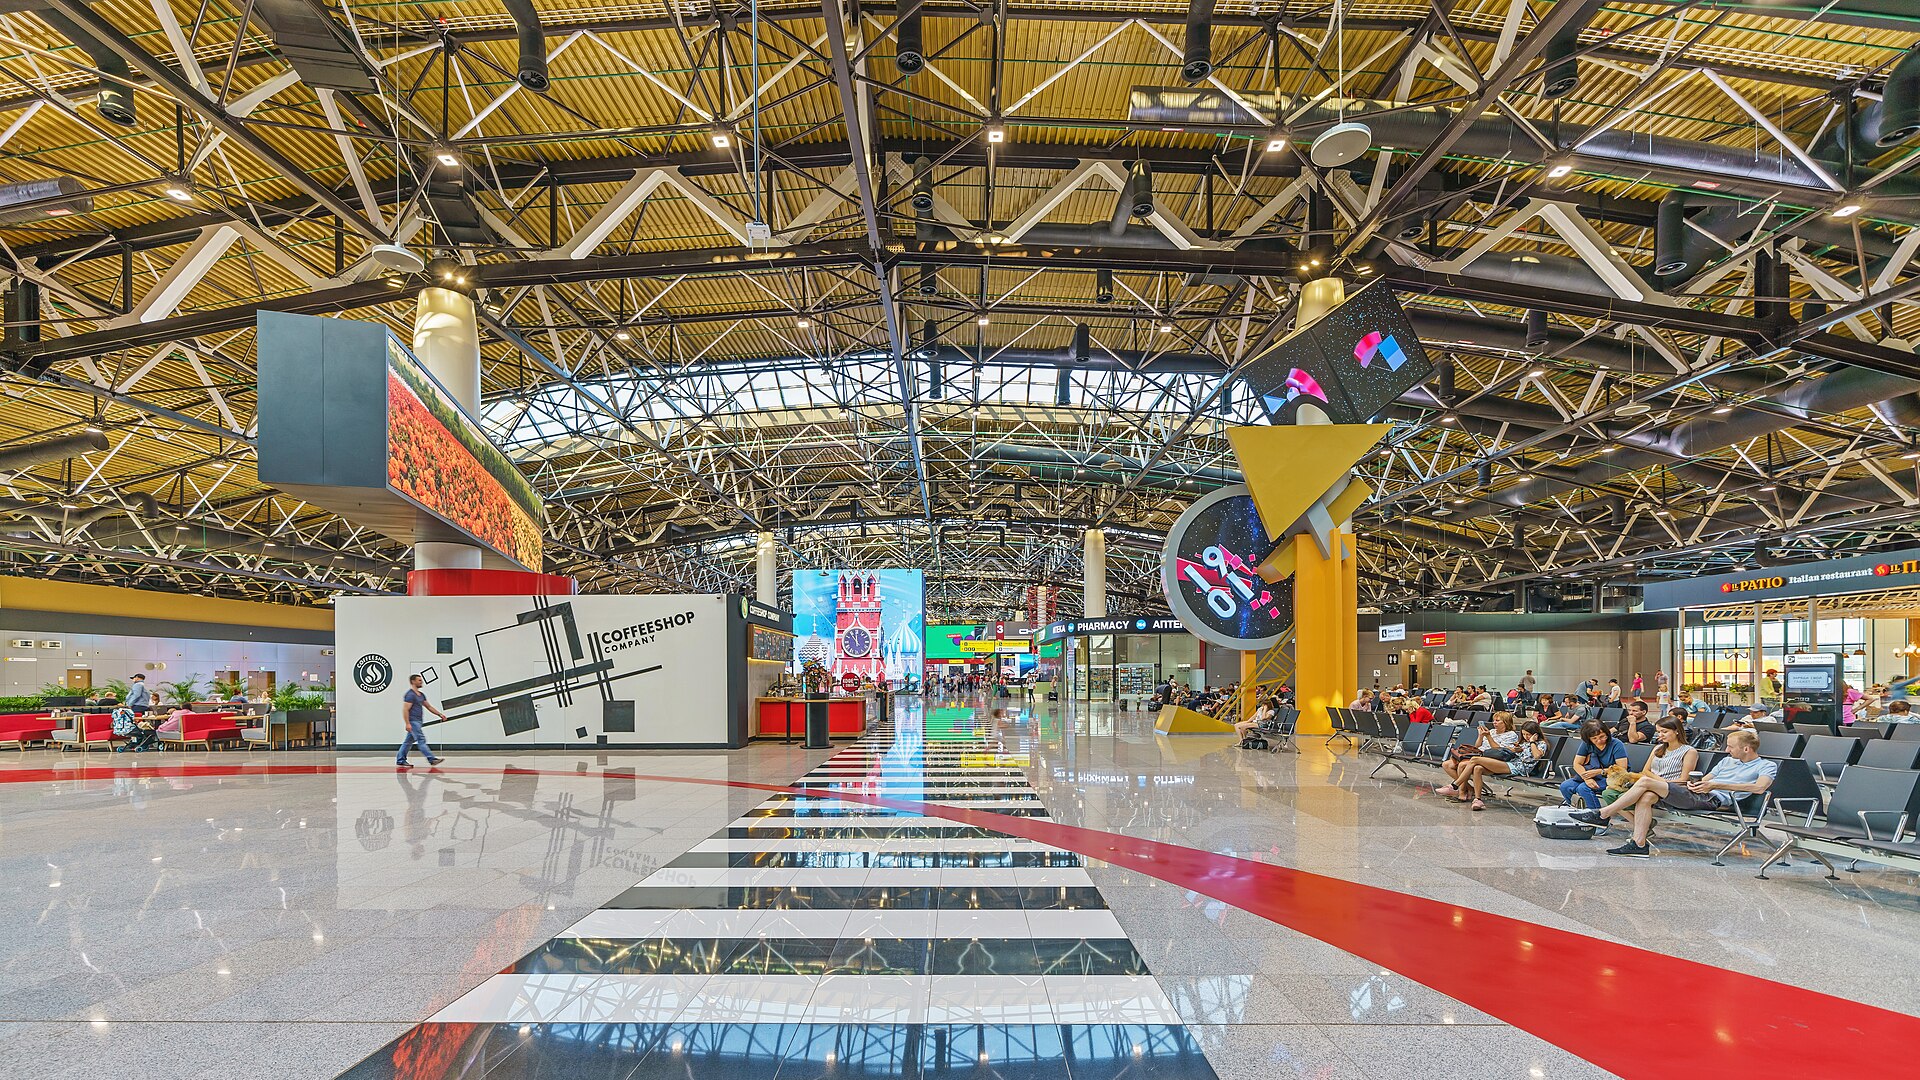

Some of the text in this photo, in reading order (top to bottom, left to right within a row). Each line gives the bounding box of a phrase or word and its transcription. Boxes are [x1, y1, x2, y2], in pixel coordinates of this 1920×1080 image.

[1902, 559, 1920, 574] П
[1740, 576, 1783, 592] PATIO
[1788, 573, 1819, 584] Italian
[1820, 567, 1873, 581] restaurant
[601, 611, 695, 645] COFFEESHOP
[996, 625, 1004, 634] 3
[1077, 620, 1129, 632] PHARMACY
[1152, 619, 1183, 629] АПТЕ
[604, 634, 656, 654] COMPANY
[356, 654, 389, 669] COFFEESHOP
[359, 682, 388, 693] COMPANY
